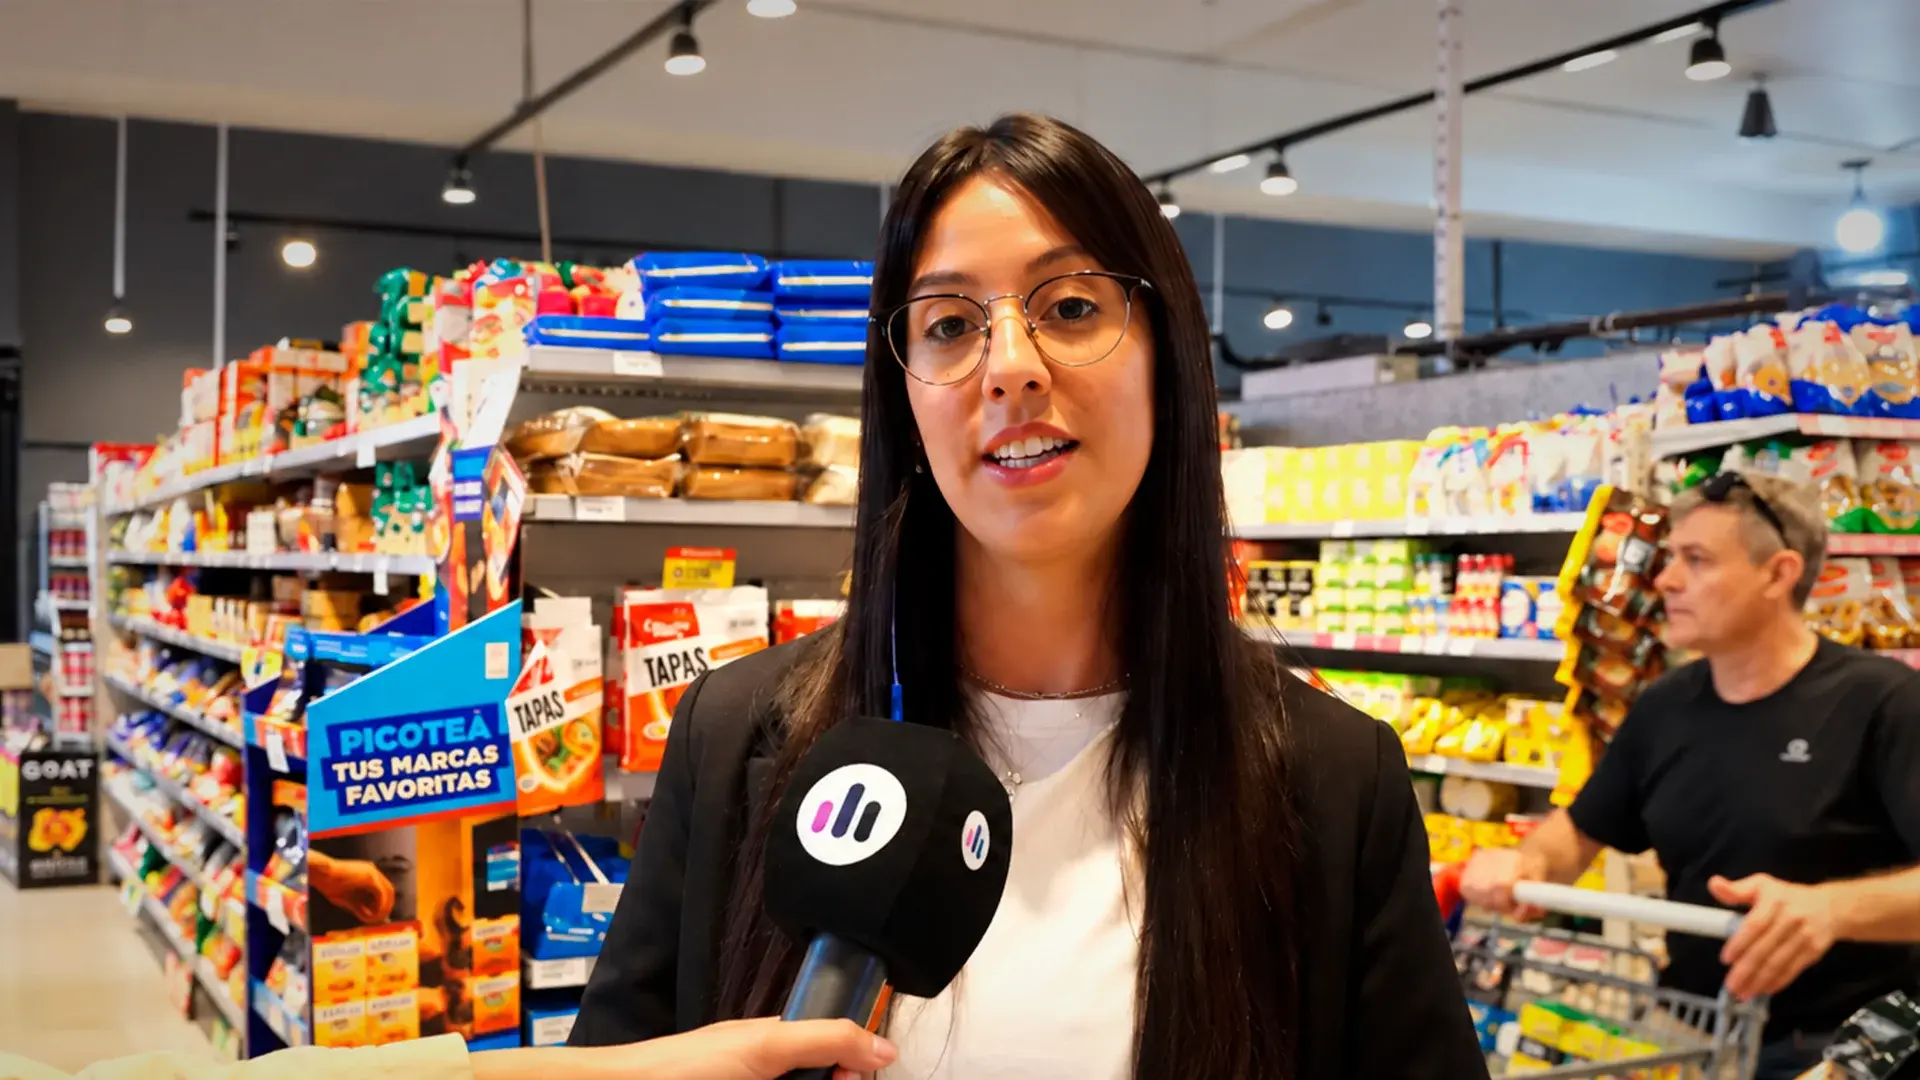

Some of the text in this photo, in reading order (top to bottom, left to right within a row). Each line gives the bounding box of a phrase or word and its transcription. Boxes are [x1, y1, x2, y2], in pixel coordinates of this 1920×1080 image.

[644, 647, 709, 687] TAPAS
[514, 690, 565, 733] TAPAS
[22, 759, 93, 781] GOAT
[332, 745, 499, 783] TUS MARCAS
[345, 769, 492, 806] FAVORITAS
